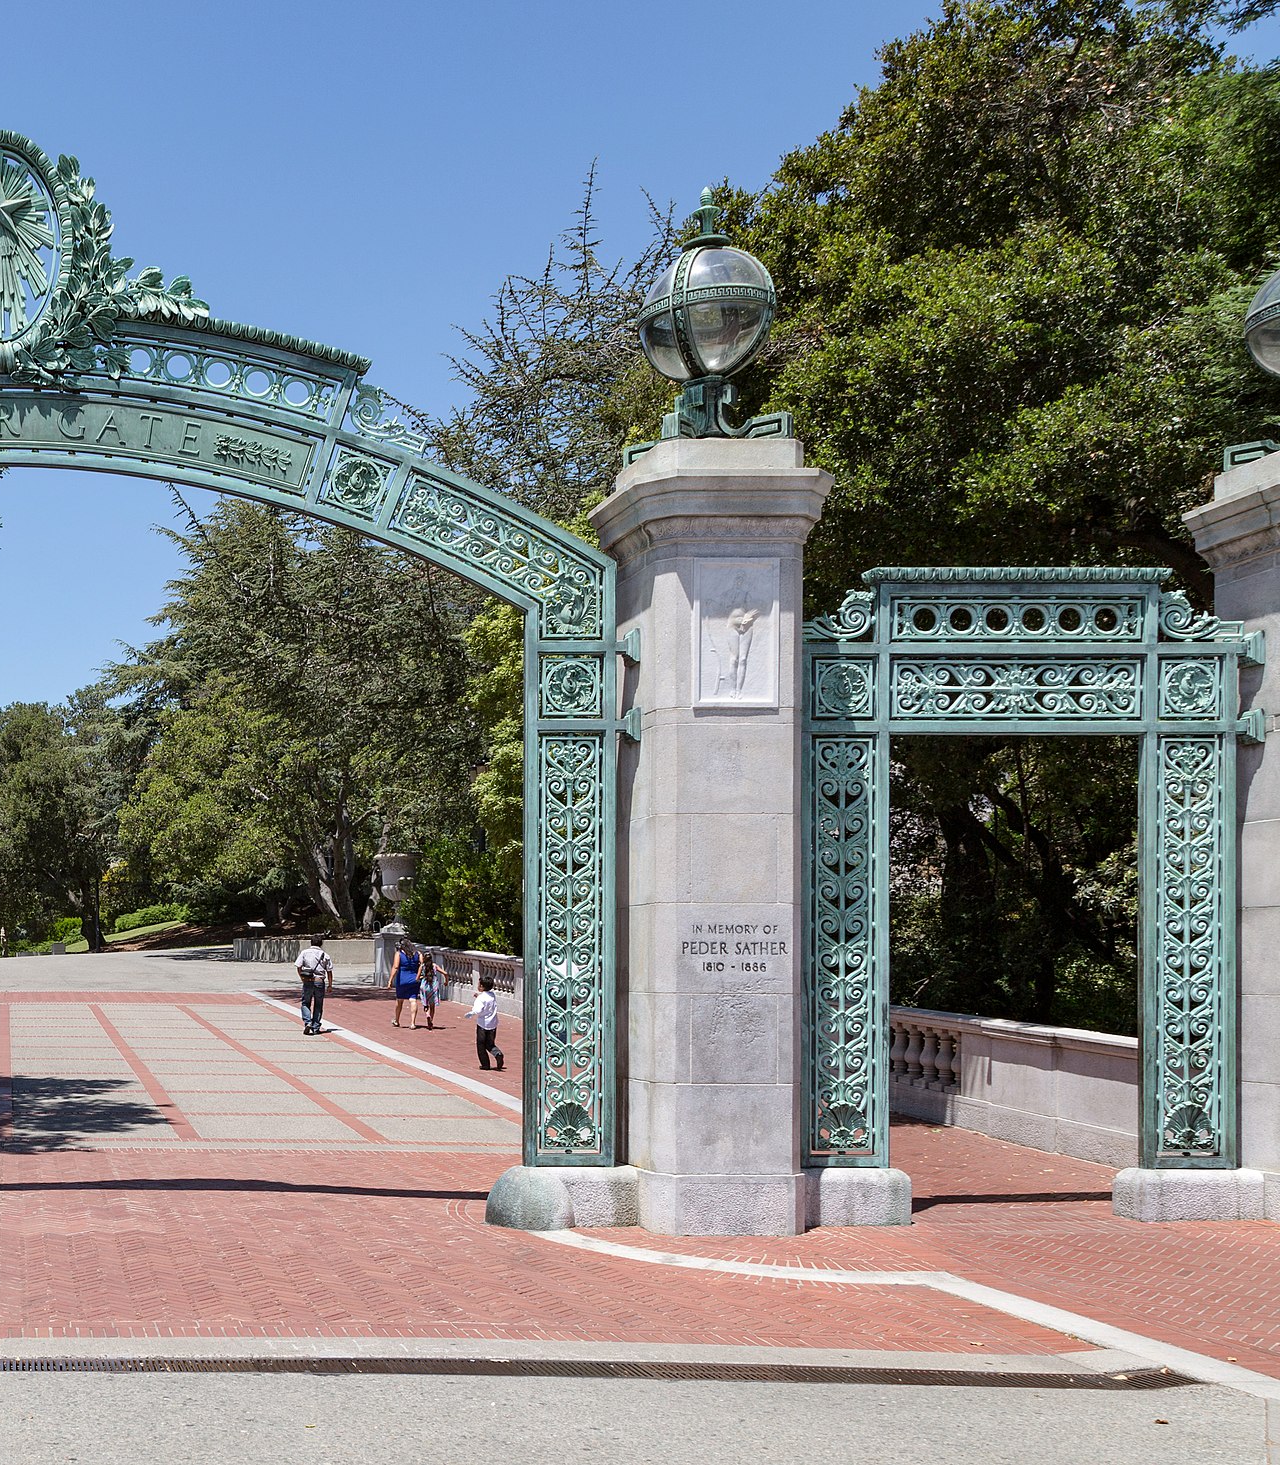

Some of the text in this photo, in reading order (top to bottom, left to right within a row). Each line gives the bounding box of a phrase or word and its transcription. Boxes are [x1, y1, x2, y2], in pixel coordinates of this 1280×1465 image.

[57, 406, 202, 457] GATE
[692, 924, 778, 934] IN MEMORY OF
[682, 941, 789, 955] PEDER SATHER
[702, 962, 725, 972] 1810
[741, 962, 767, 972] 1886
